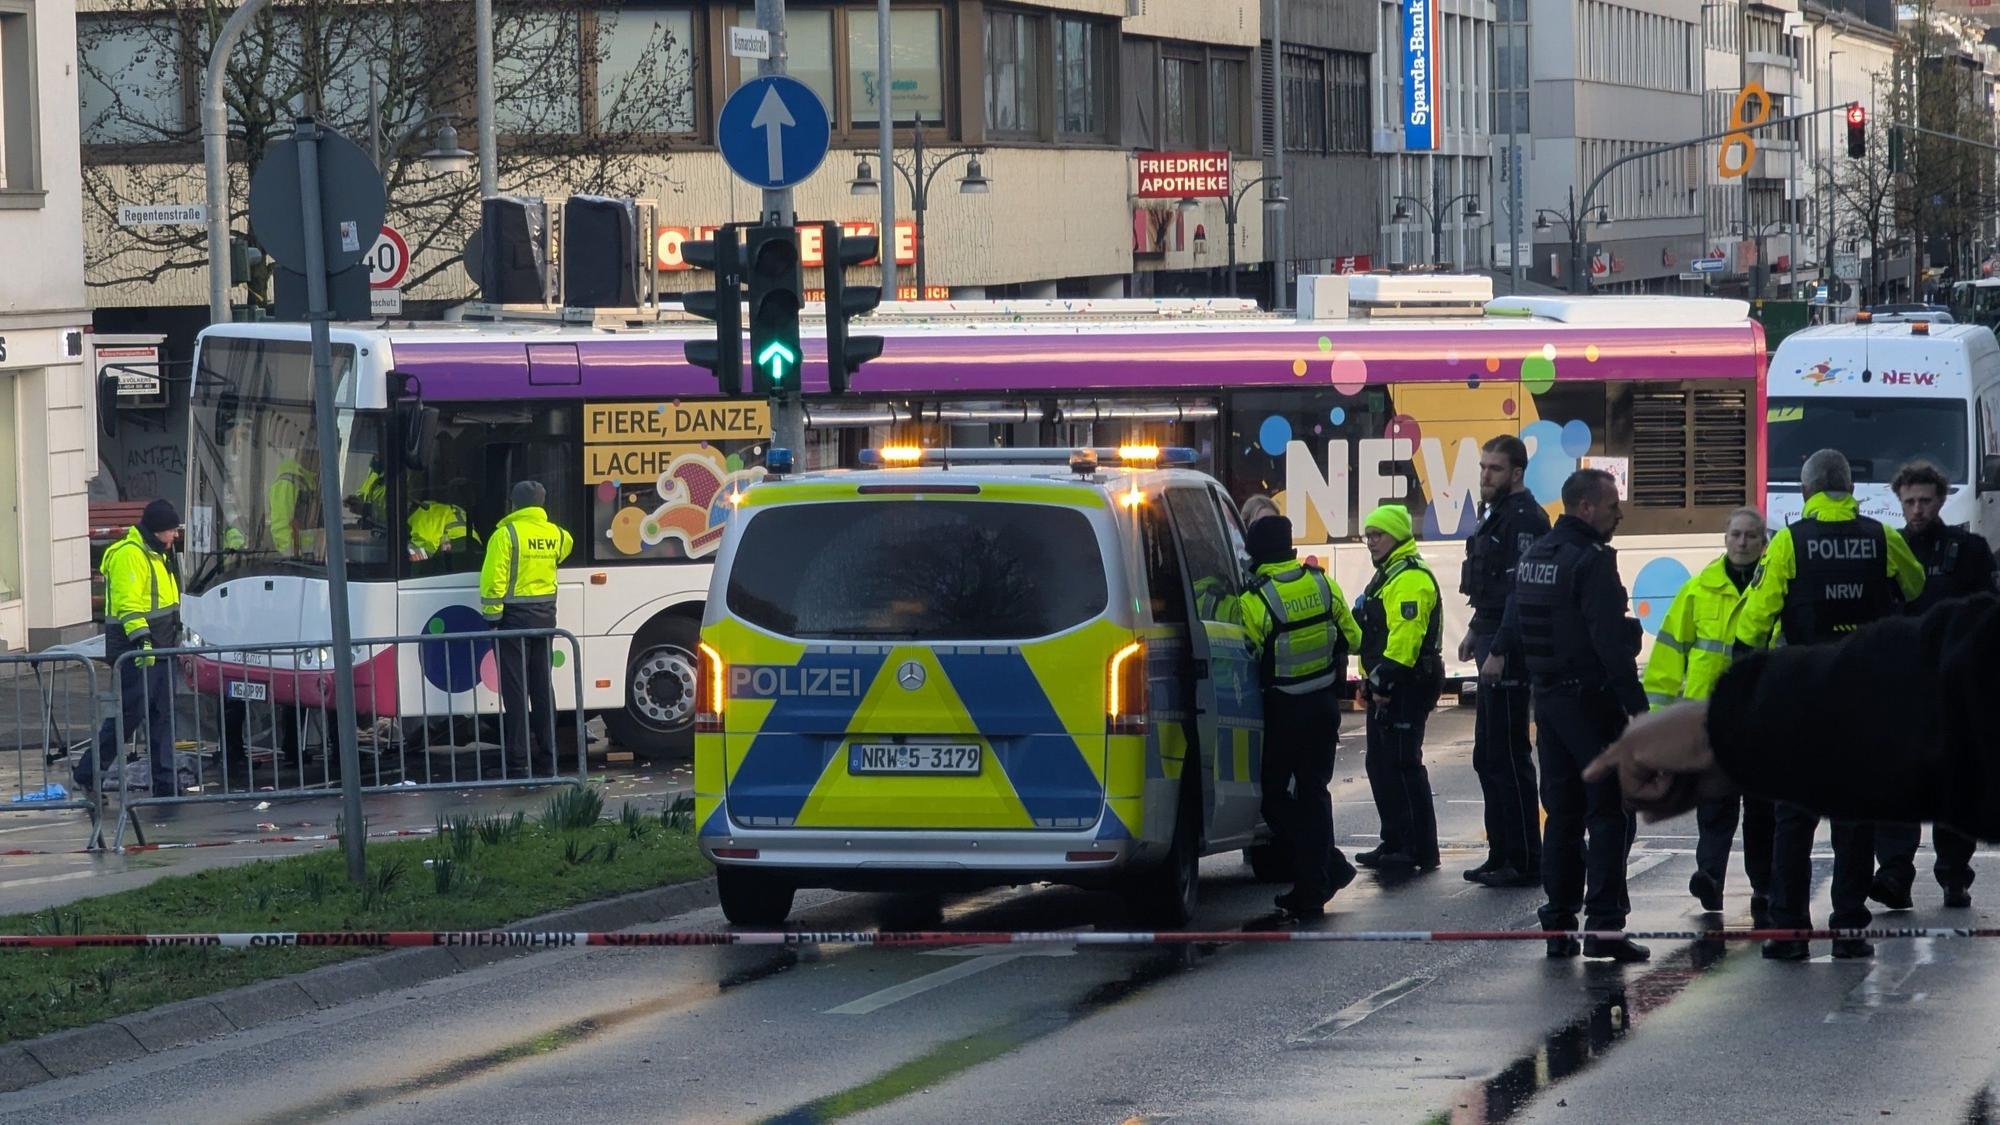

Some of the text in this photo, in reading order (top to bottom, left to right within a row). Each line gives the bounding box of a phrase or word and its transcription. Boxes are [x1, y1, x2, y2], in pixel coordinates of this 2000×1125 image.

[1410, 0, 1429, 125] Sparda-Bank
[1140, 158, 1228, 173] FRIEDRICH
[1141, 176, 1228, 191] APOTHEKE
[125, 208, 200, 223] Regentenstraße
[1883, 371, 1935, 385] NEW
[592, 408, 763, 438] FIERE, DANZE,
[592, 452, 672, 476] LACHE
[1286, 437, 1483, 539] NEW
[528, 538, 556, 550] NEW
[1807, 539, 1877, 560] POLIZEI
[1517, 561, 1559, 584] POLIZEI
[1825, 584, 1864, 599] NRW
[731, 668, 860, 696] POLIZEI
[861, 748, 979, 769] NRW 5-3179
